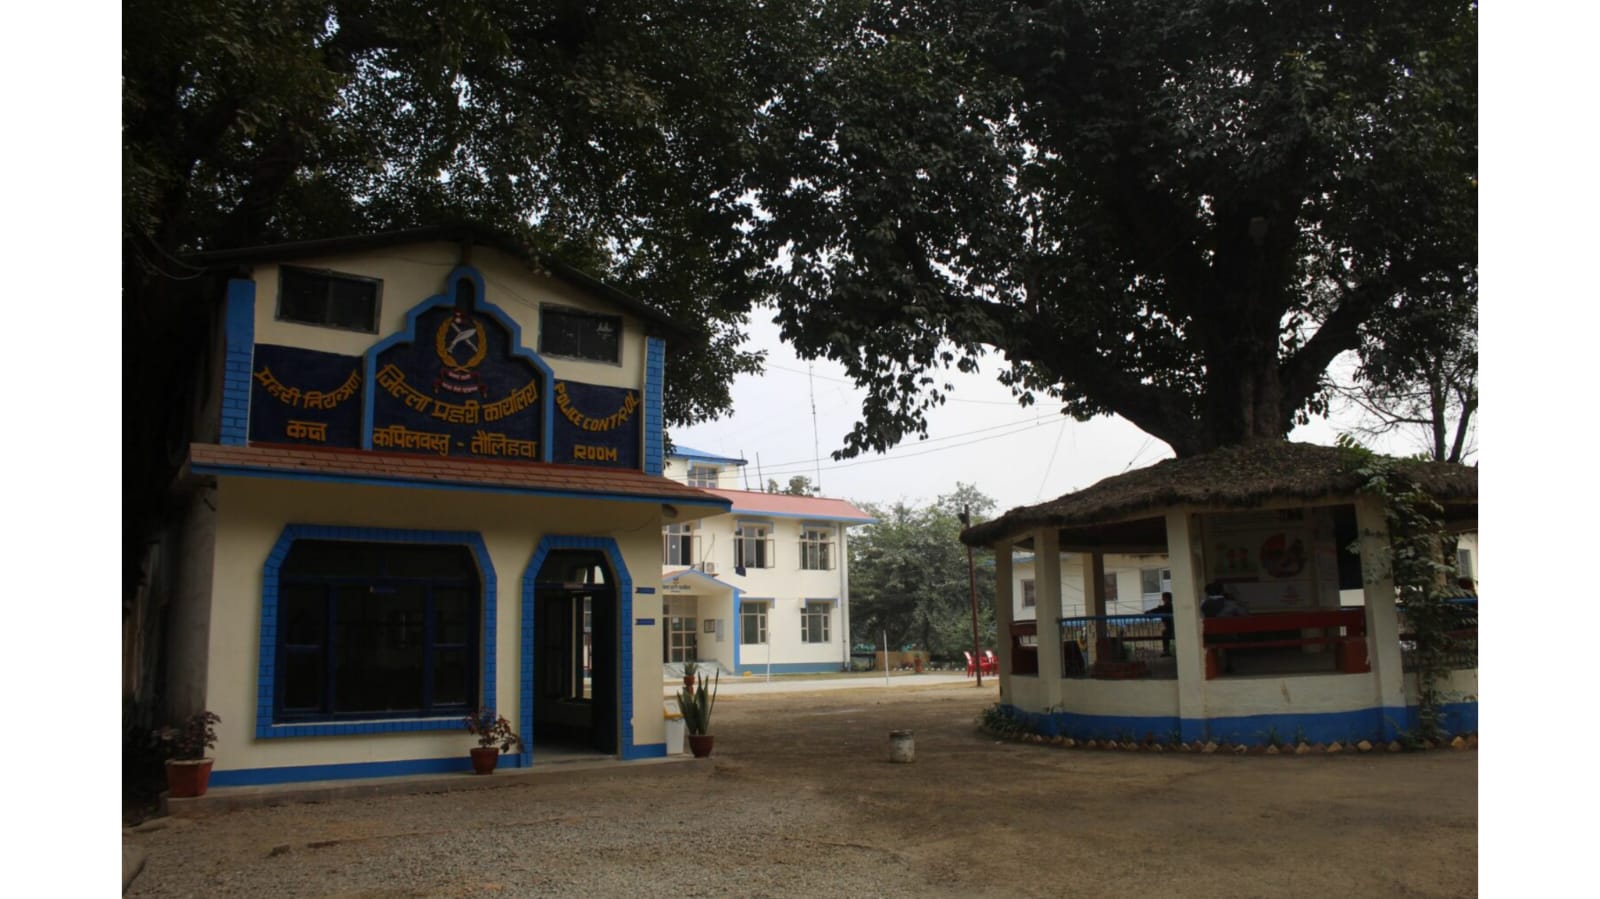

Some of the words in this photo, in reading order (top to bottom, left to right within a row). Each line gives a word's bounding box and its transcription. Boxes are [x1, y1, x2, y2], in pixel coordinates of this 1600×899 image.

[254, 365, 301, 408] प्रहरी
[376, 363, 433, 413] जिल्ला
[431, 399, 480, 425] प्रहरी
[482, 378, 539, 423] कार्यालय
[554, 382, 585, 427] POLICE
[582, 390, 640, 432] CONTROL
[373, 424, 452, 457] कपिलवस्तु
[471, 429, 537, 458] तौलिहवा
[573, 444, 618, 463] ROOM
